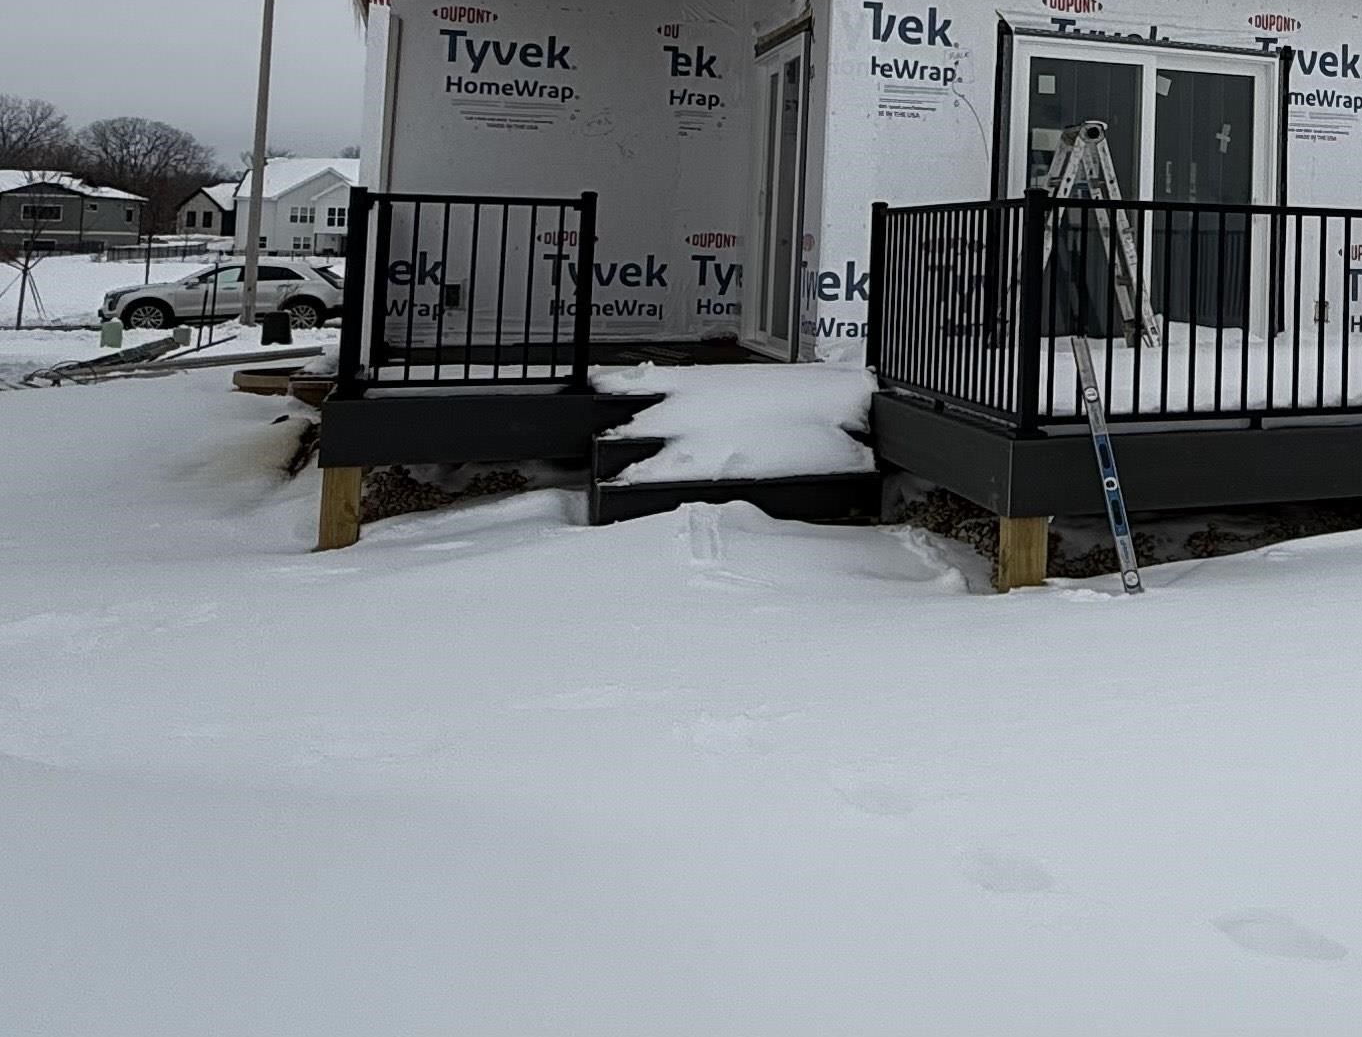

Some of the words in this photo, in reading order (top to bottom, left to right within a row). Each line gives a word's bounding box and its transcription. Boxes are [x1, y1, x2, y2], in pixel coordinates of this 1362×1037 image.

[441, 6, 492, 24] DUPONT
[1255, 14, 1296, 32] DUPONT
[440, 29, 570, 74] Tyvek
[445, 76, 574, 103] HomeWrap
[692, 233, 737, 248] DUPONT
